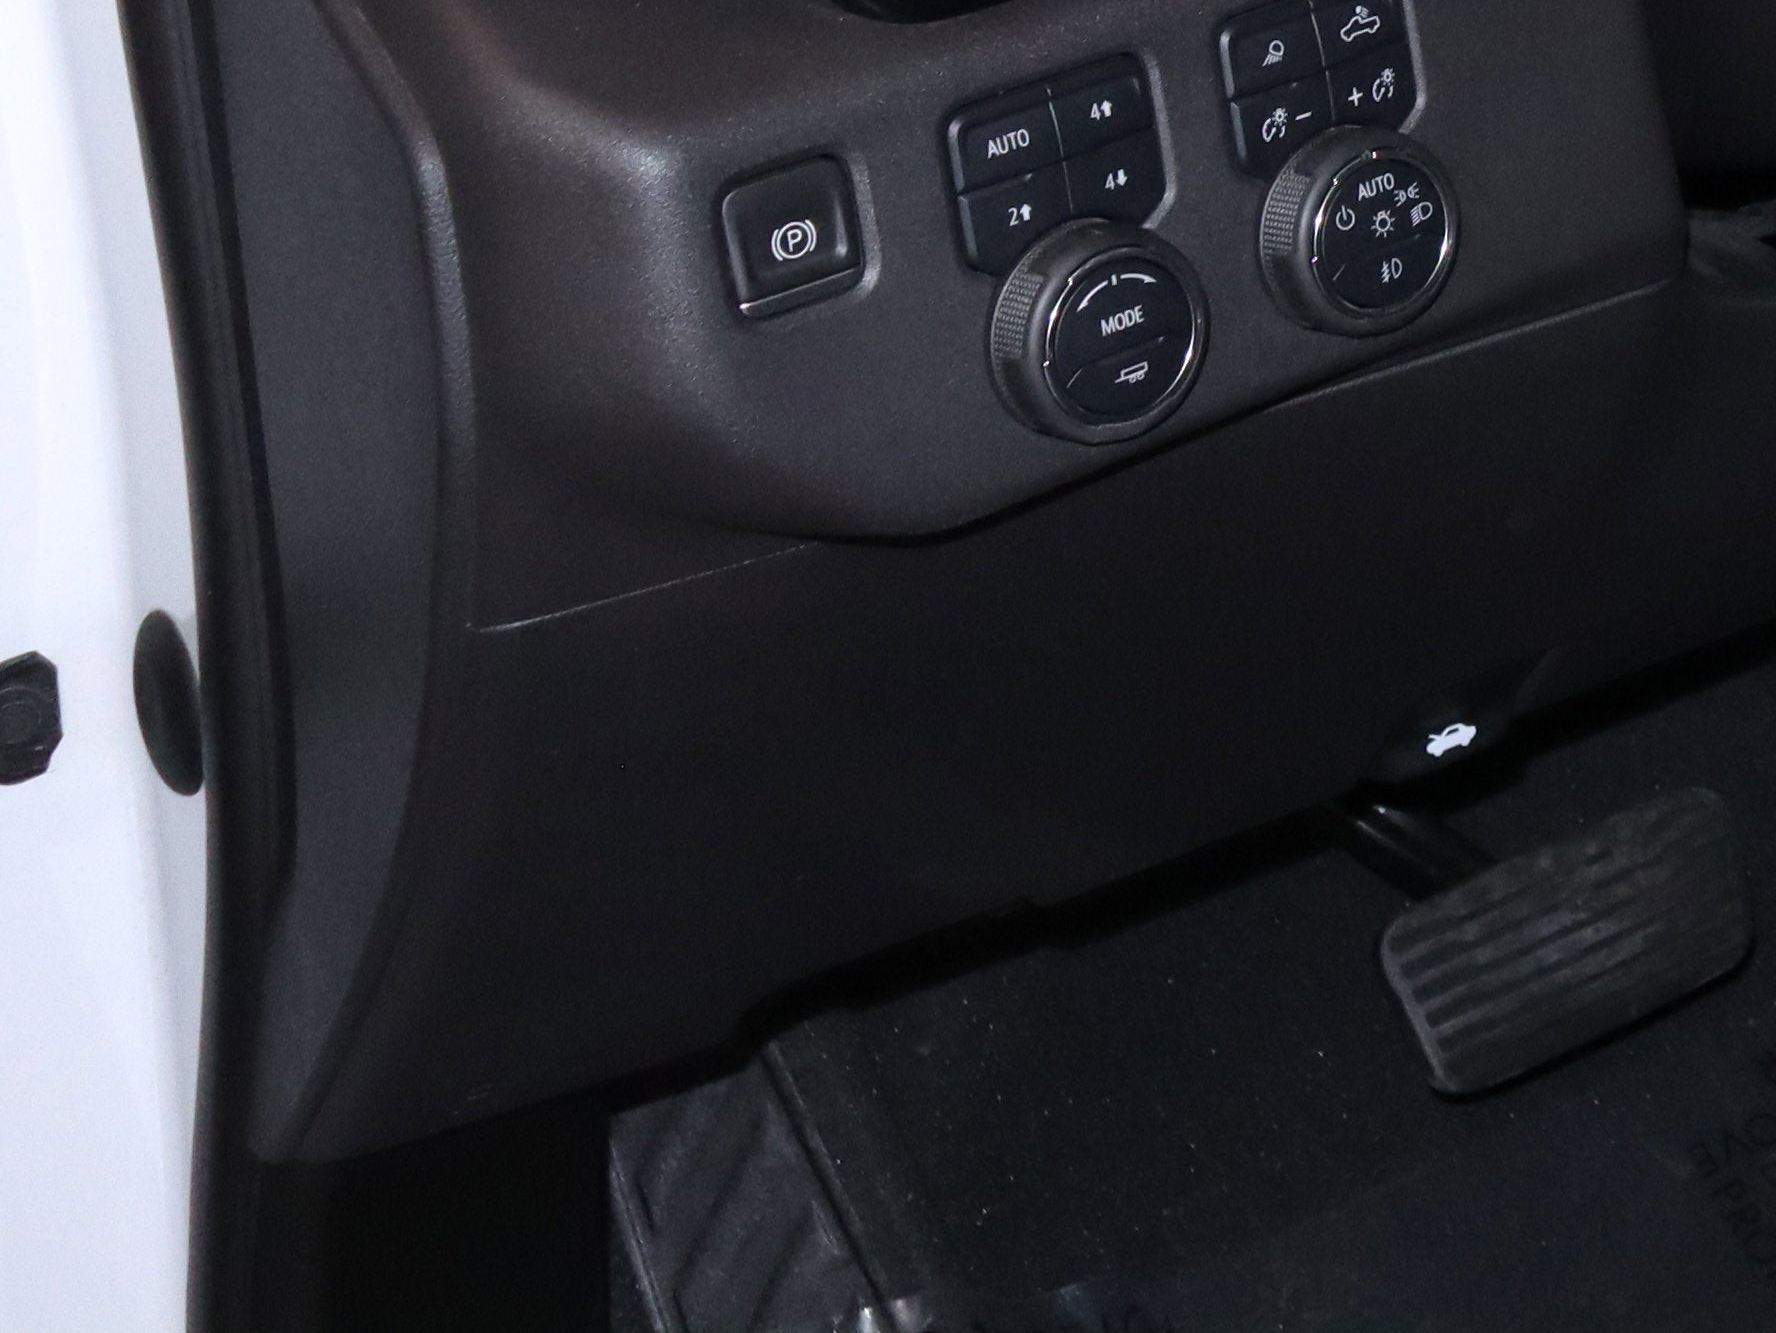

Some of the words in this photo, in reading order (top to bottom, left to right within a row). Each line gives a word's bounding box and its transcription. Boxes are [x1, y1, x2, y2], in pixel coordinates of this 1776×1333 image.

[987, 128, 1030, 159] AUTO
[1358, 172, 1395, 201] AUTO
[1100, 304, 1146, 337] MODE
